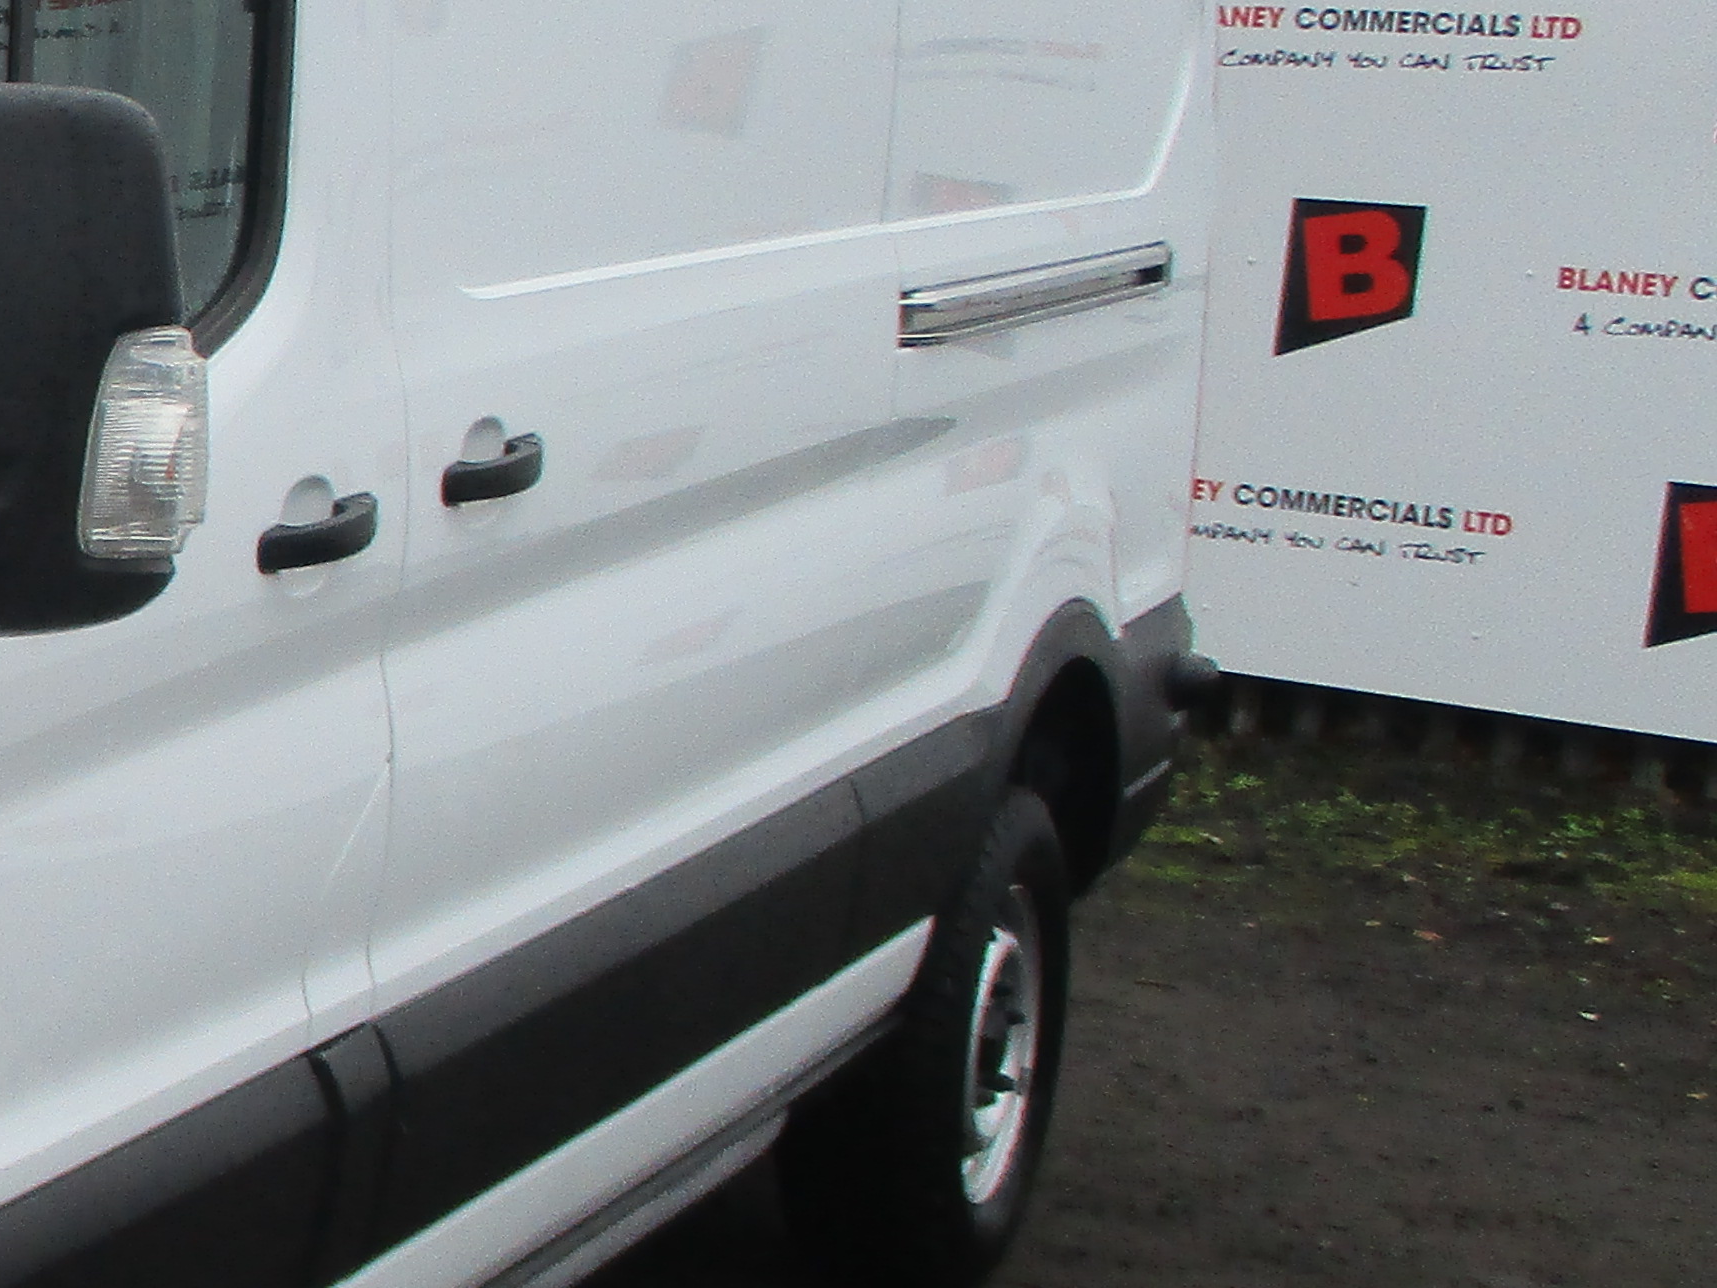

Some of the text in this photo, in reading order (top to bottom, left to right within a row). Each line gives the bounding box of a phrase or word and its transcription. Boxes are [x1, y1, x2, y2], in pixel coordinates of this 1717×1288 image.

[1294, 7, 1523, 37] COMMERCIALS
[1531, 16, 1582, 39] LTD
[1217, 49, 1337, 68] COMPANY
[1399, 53, 1453, 70] CAN
[1464, 53, 1556, 71] TRUST
[1303, 212, 1407, 319] B
[1557, 267, 1679, 297] BLANEY
[1602, 317, 1717, 341] COMPAN
[1233, 484, 1455, 529] COMMERCIALS
[1463, 510, 1512, 536] LTD
[1335, 537, 1386, 556] CAN
[1399, 543, 1486, 564] TRUST
